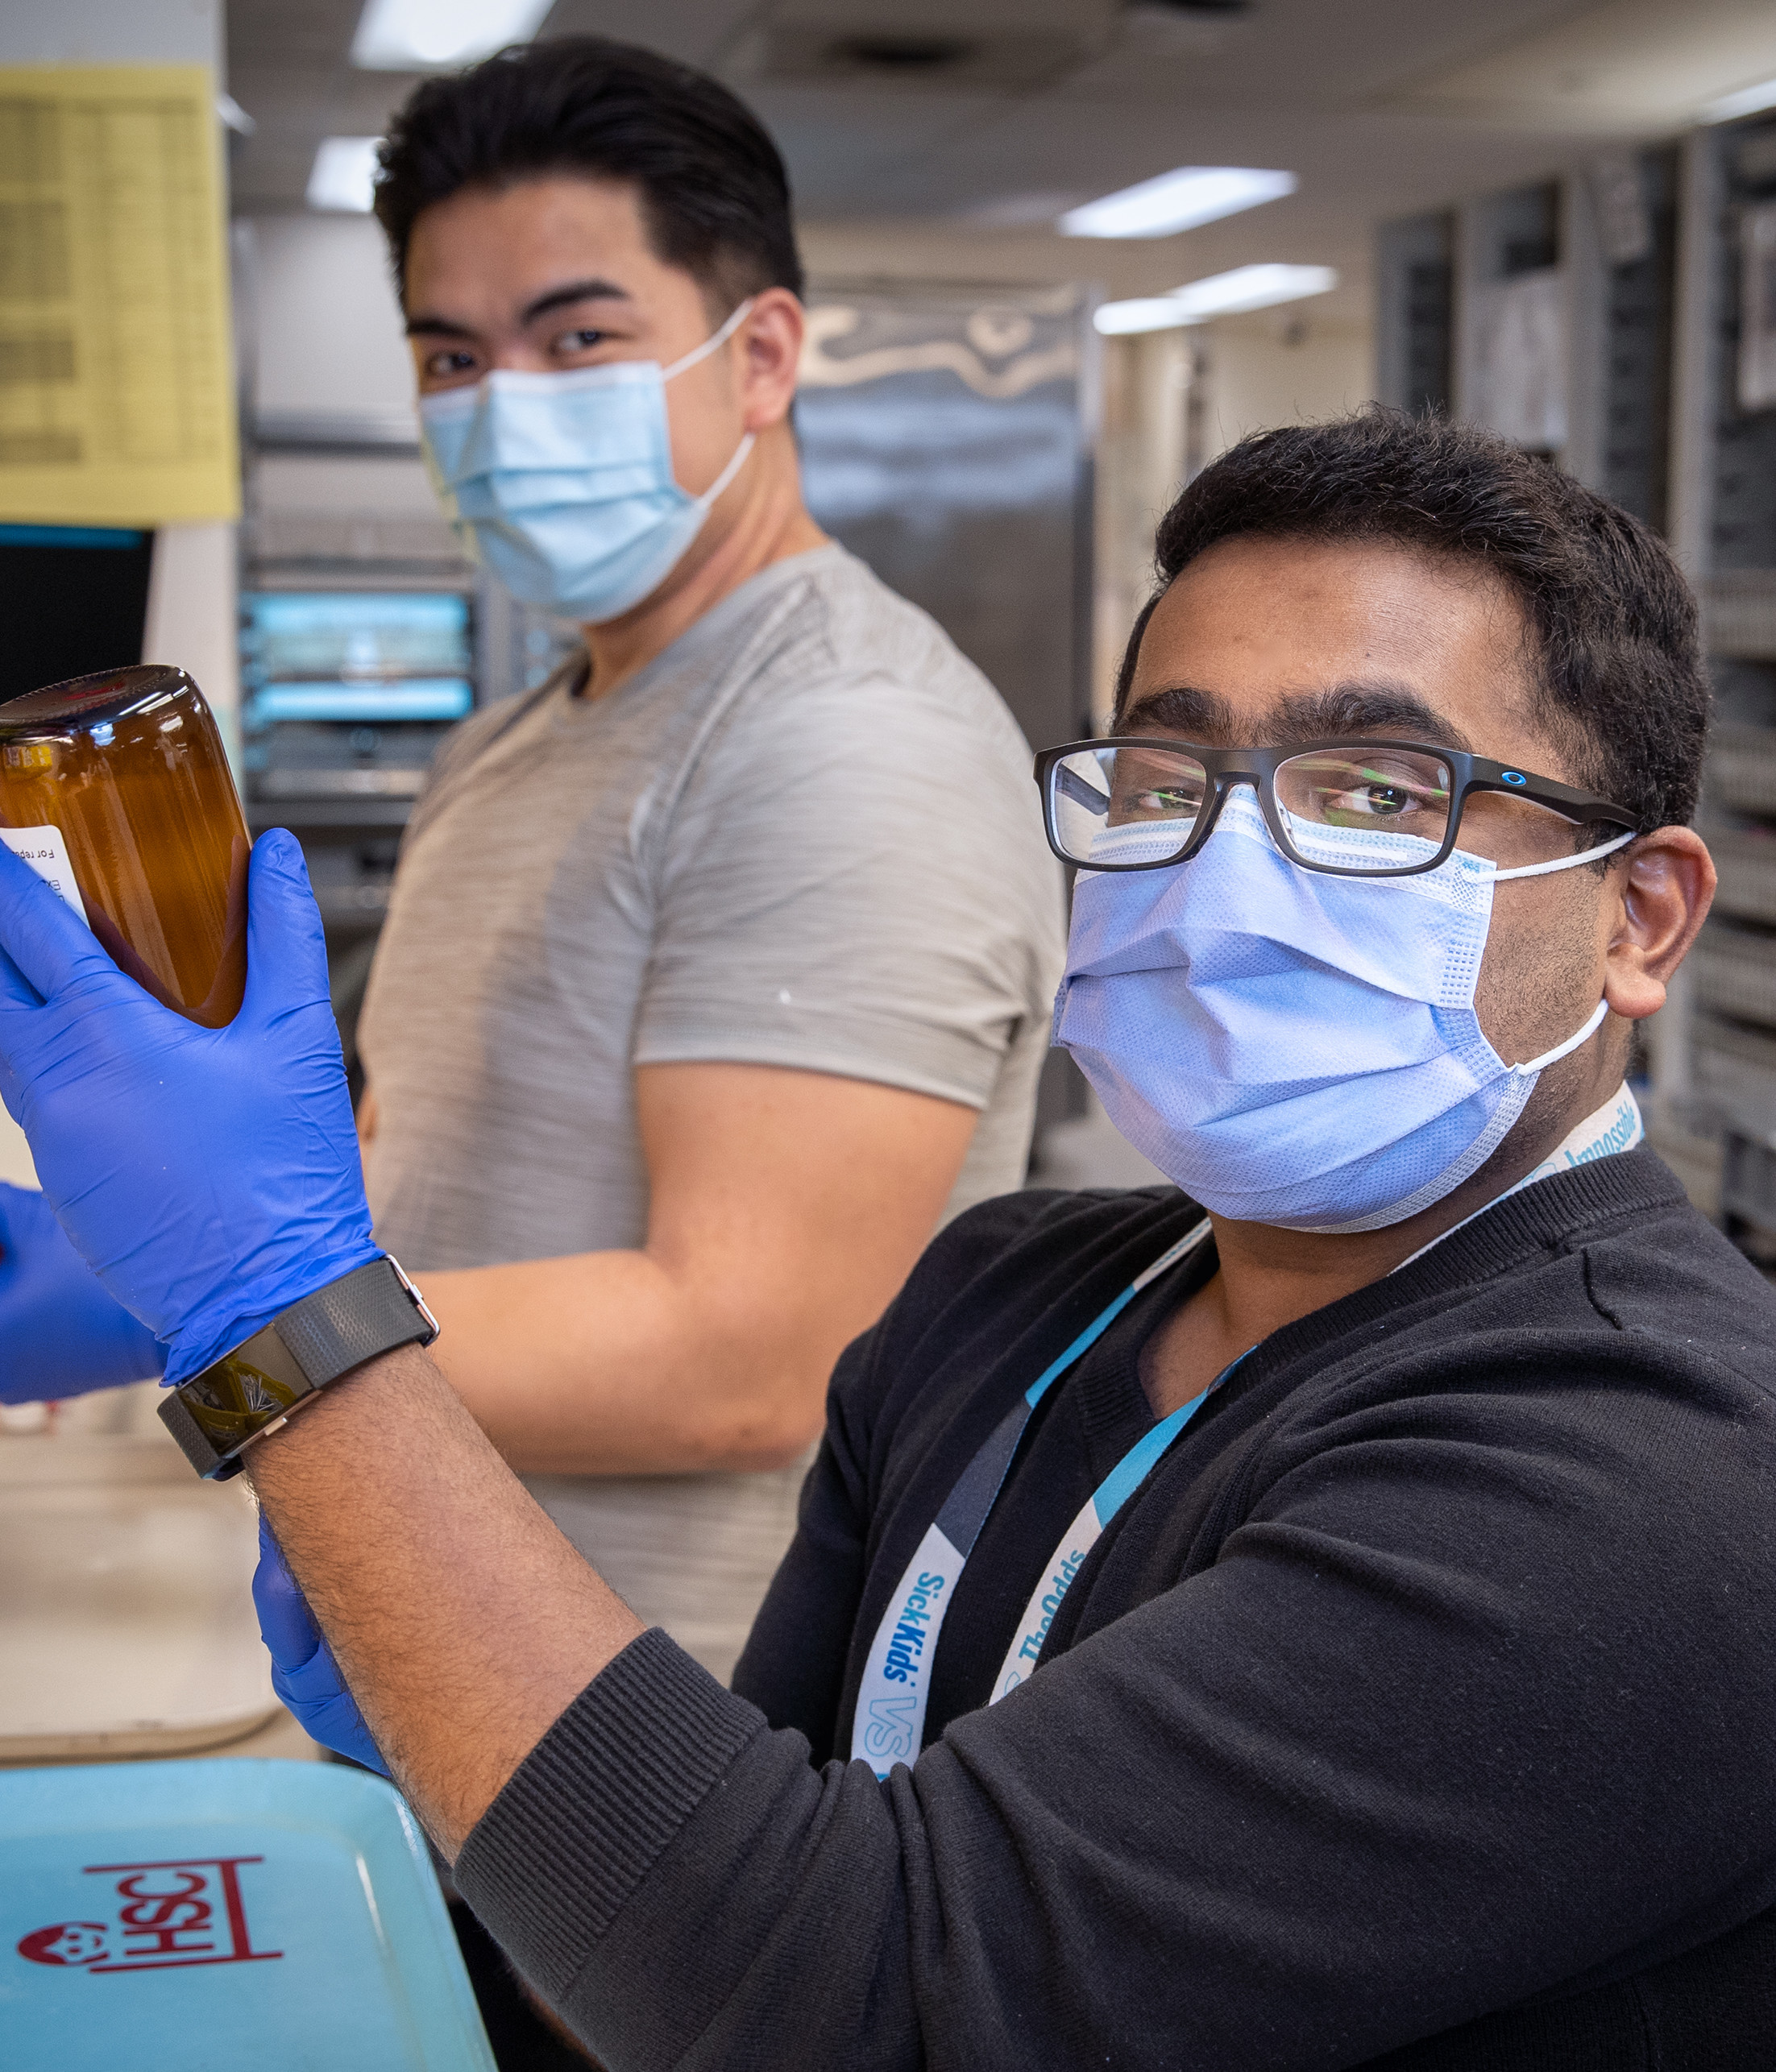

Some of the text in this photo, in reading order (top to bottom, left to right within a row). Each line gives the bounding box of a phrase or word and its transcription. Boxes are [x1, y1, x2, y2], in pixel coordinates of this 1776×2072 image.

[37, 849, 55, 859] For
[865, 1572, 944, 1757] SickKids VS
[116, 1871, 215, 1957] HSC
